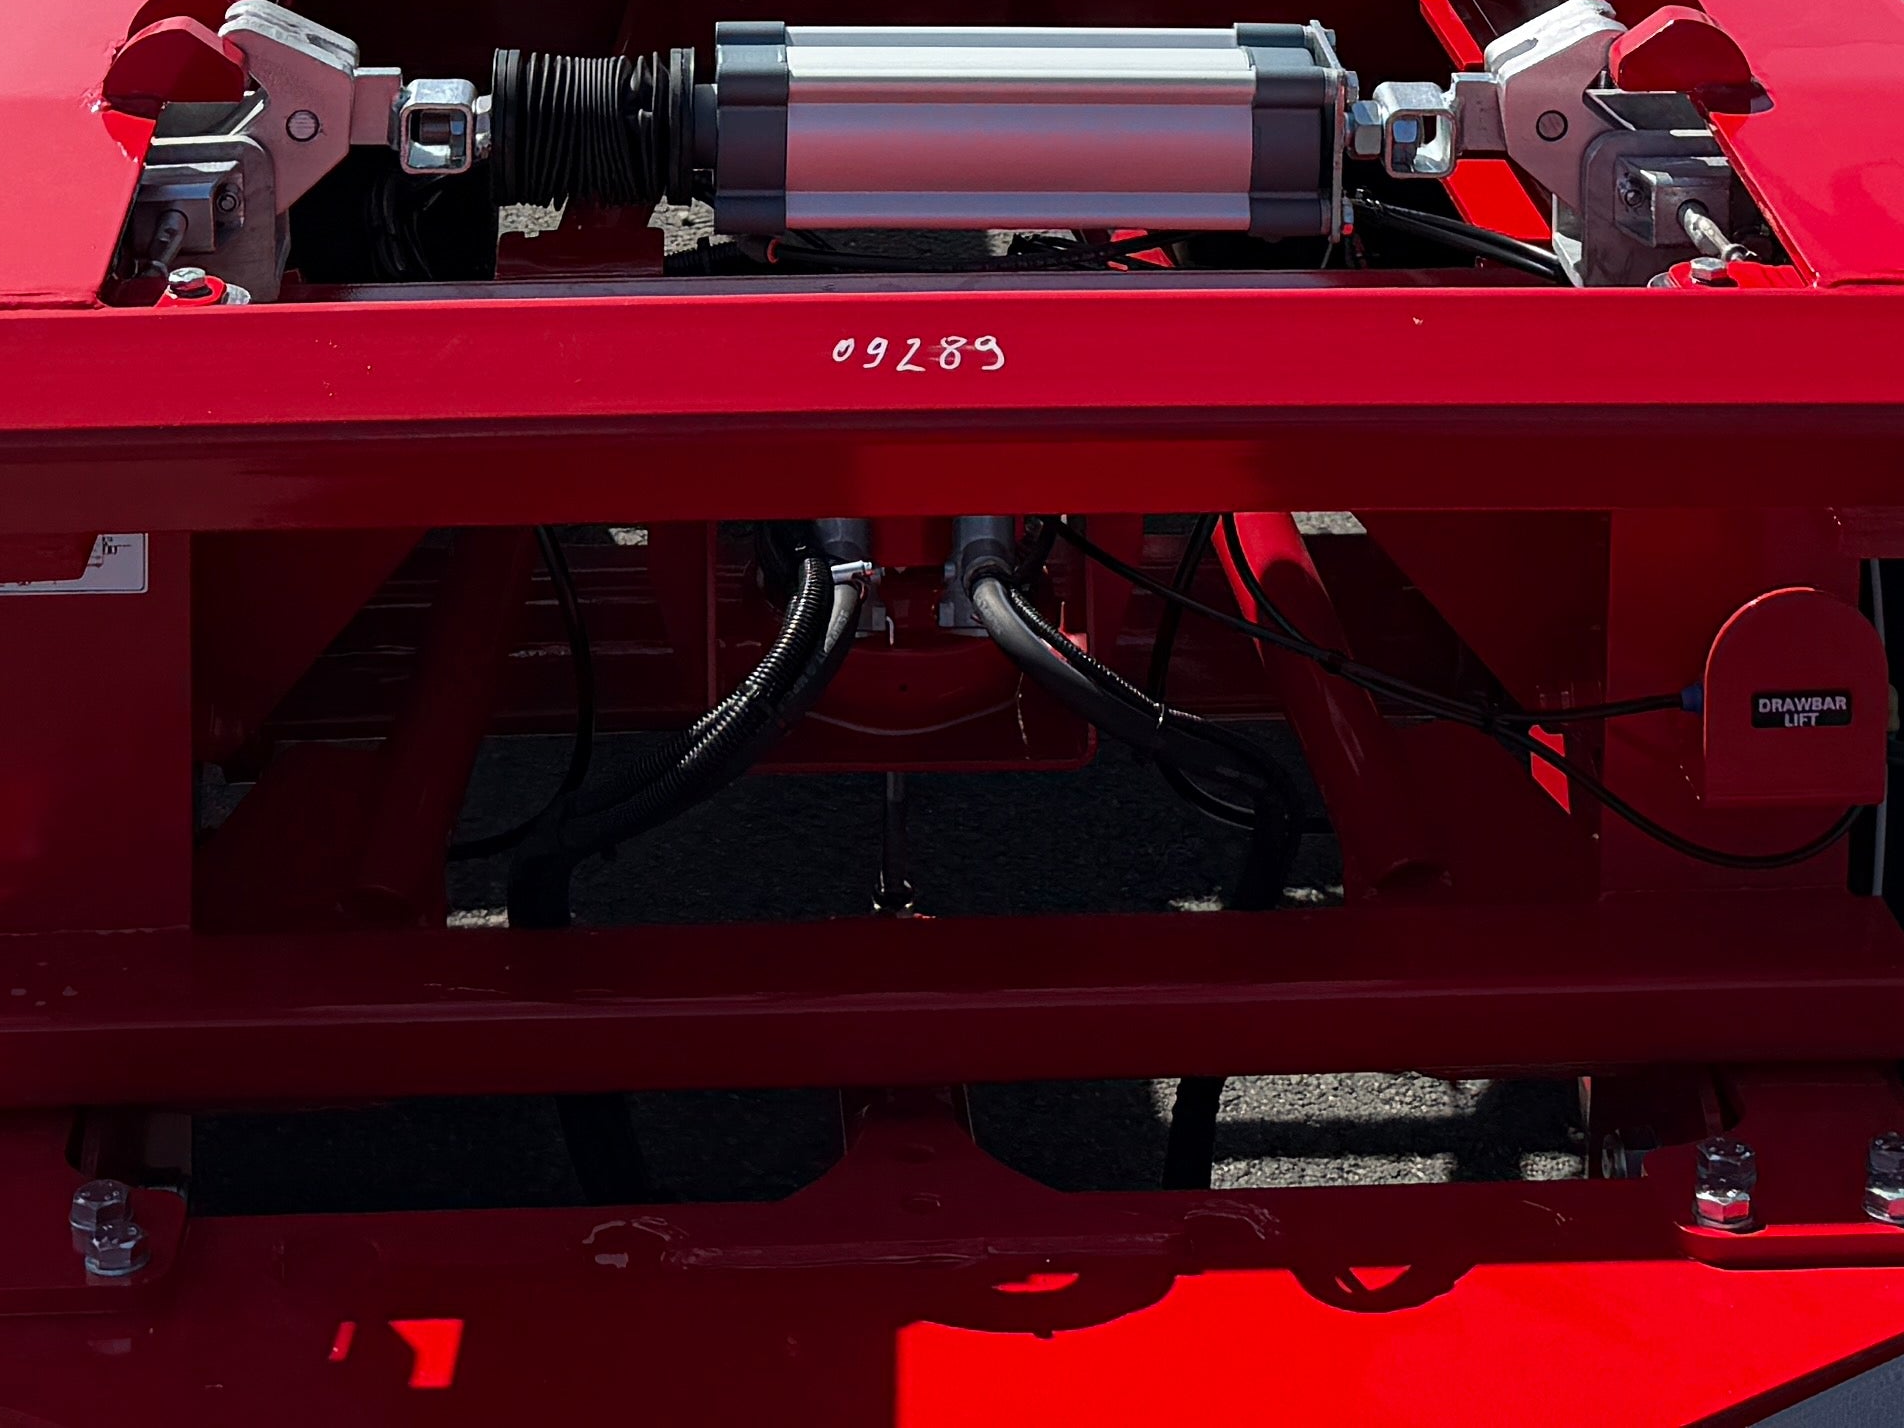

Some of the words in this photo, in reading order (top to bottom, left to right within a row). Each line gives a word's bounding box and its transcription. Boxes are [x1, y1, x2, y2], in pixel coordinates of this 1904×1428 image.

[832, 335, 1005, 372] 09289
[1758, 696, 1847, 713] DRAWBAR
[1784, 712, 1819, 727] LIFT
